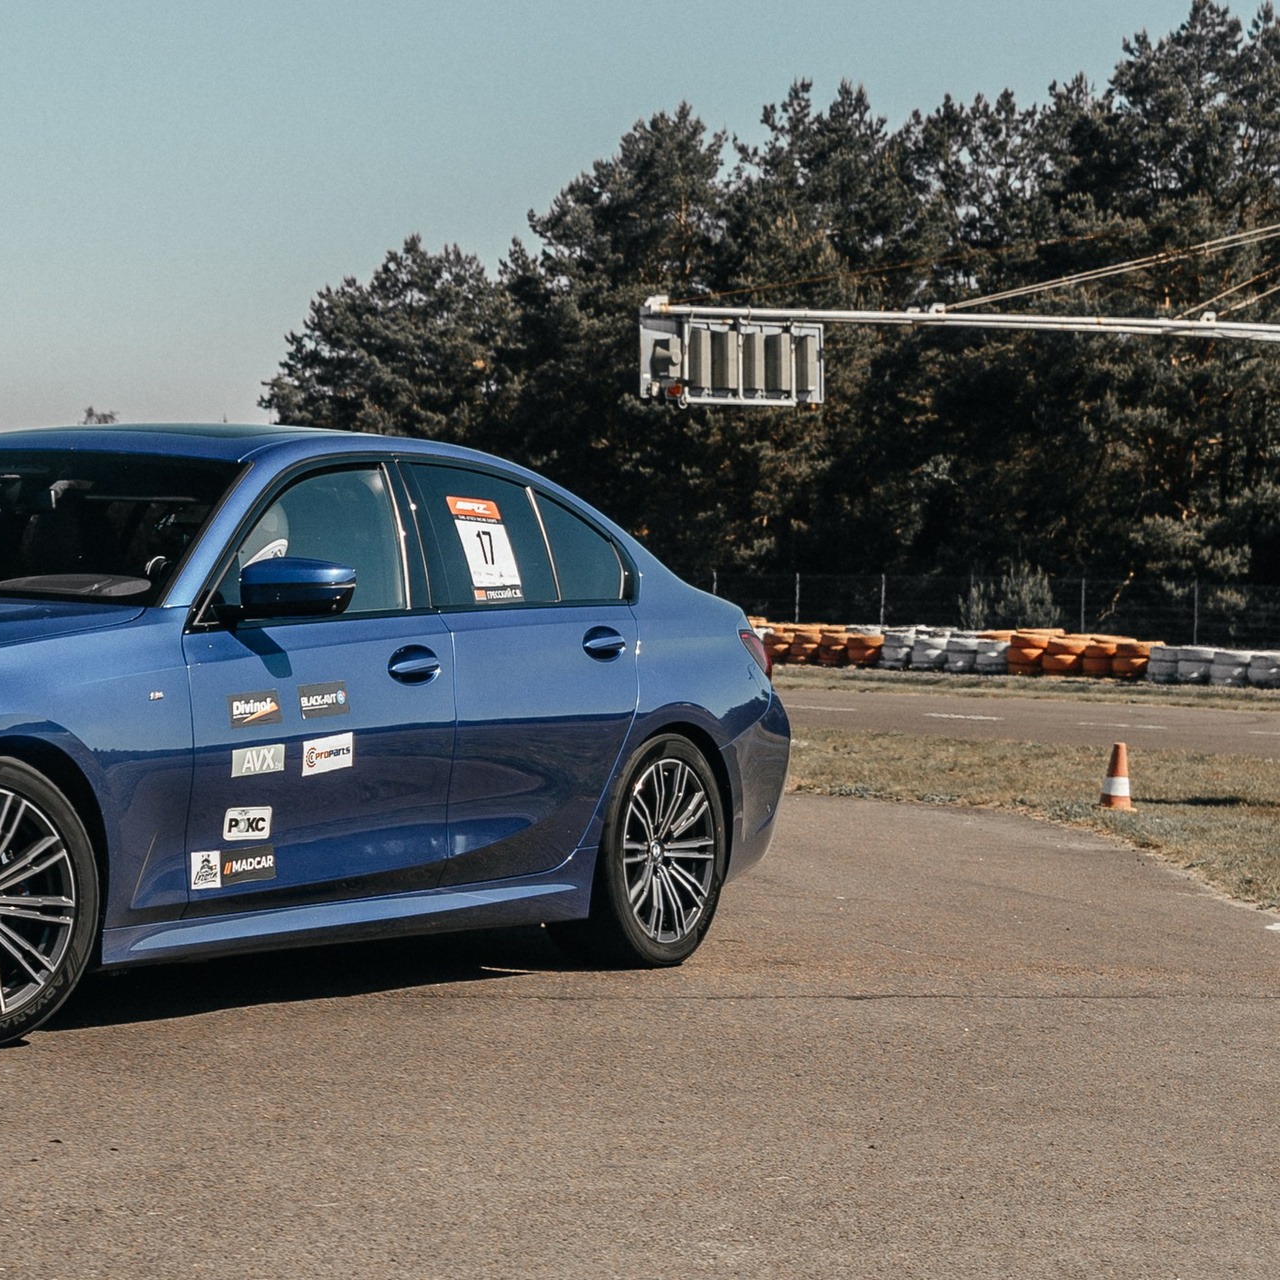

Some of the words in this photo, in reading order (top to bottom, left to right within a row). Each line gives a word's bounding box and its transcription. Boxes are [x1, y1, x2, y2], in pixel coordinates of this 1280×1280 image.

[476, 529, 494, 565] 17
[233, 698, 272, 715] Divinol
[232, 855, 274, 873] MADCAR
